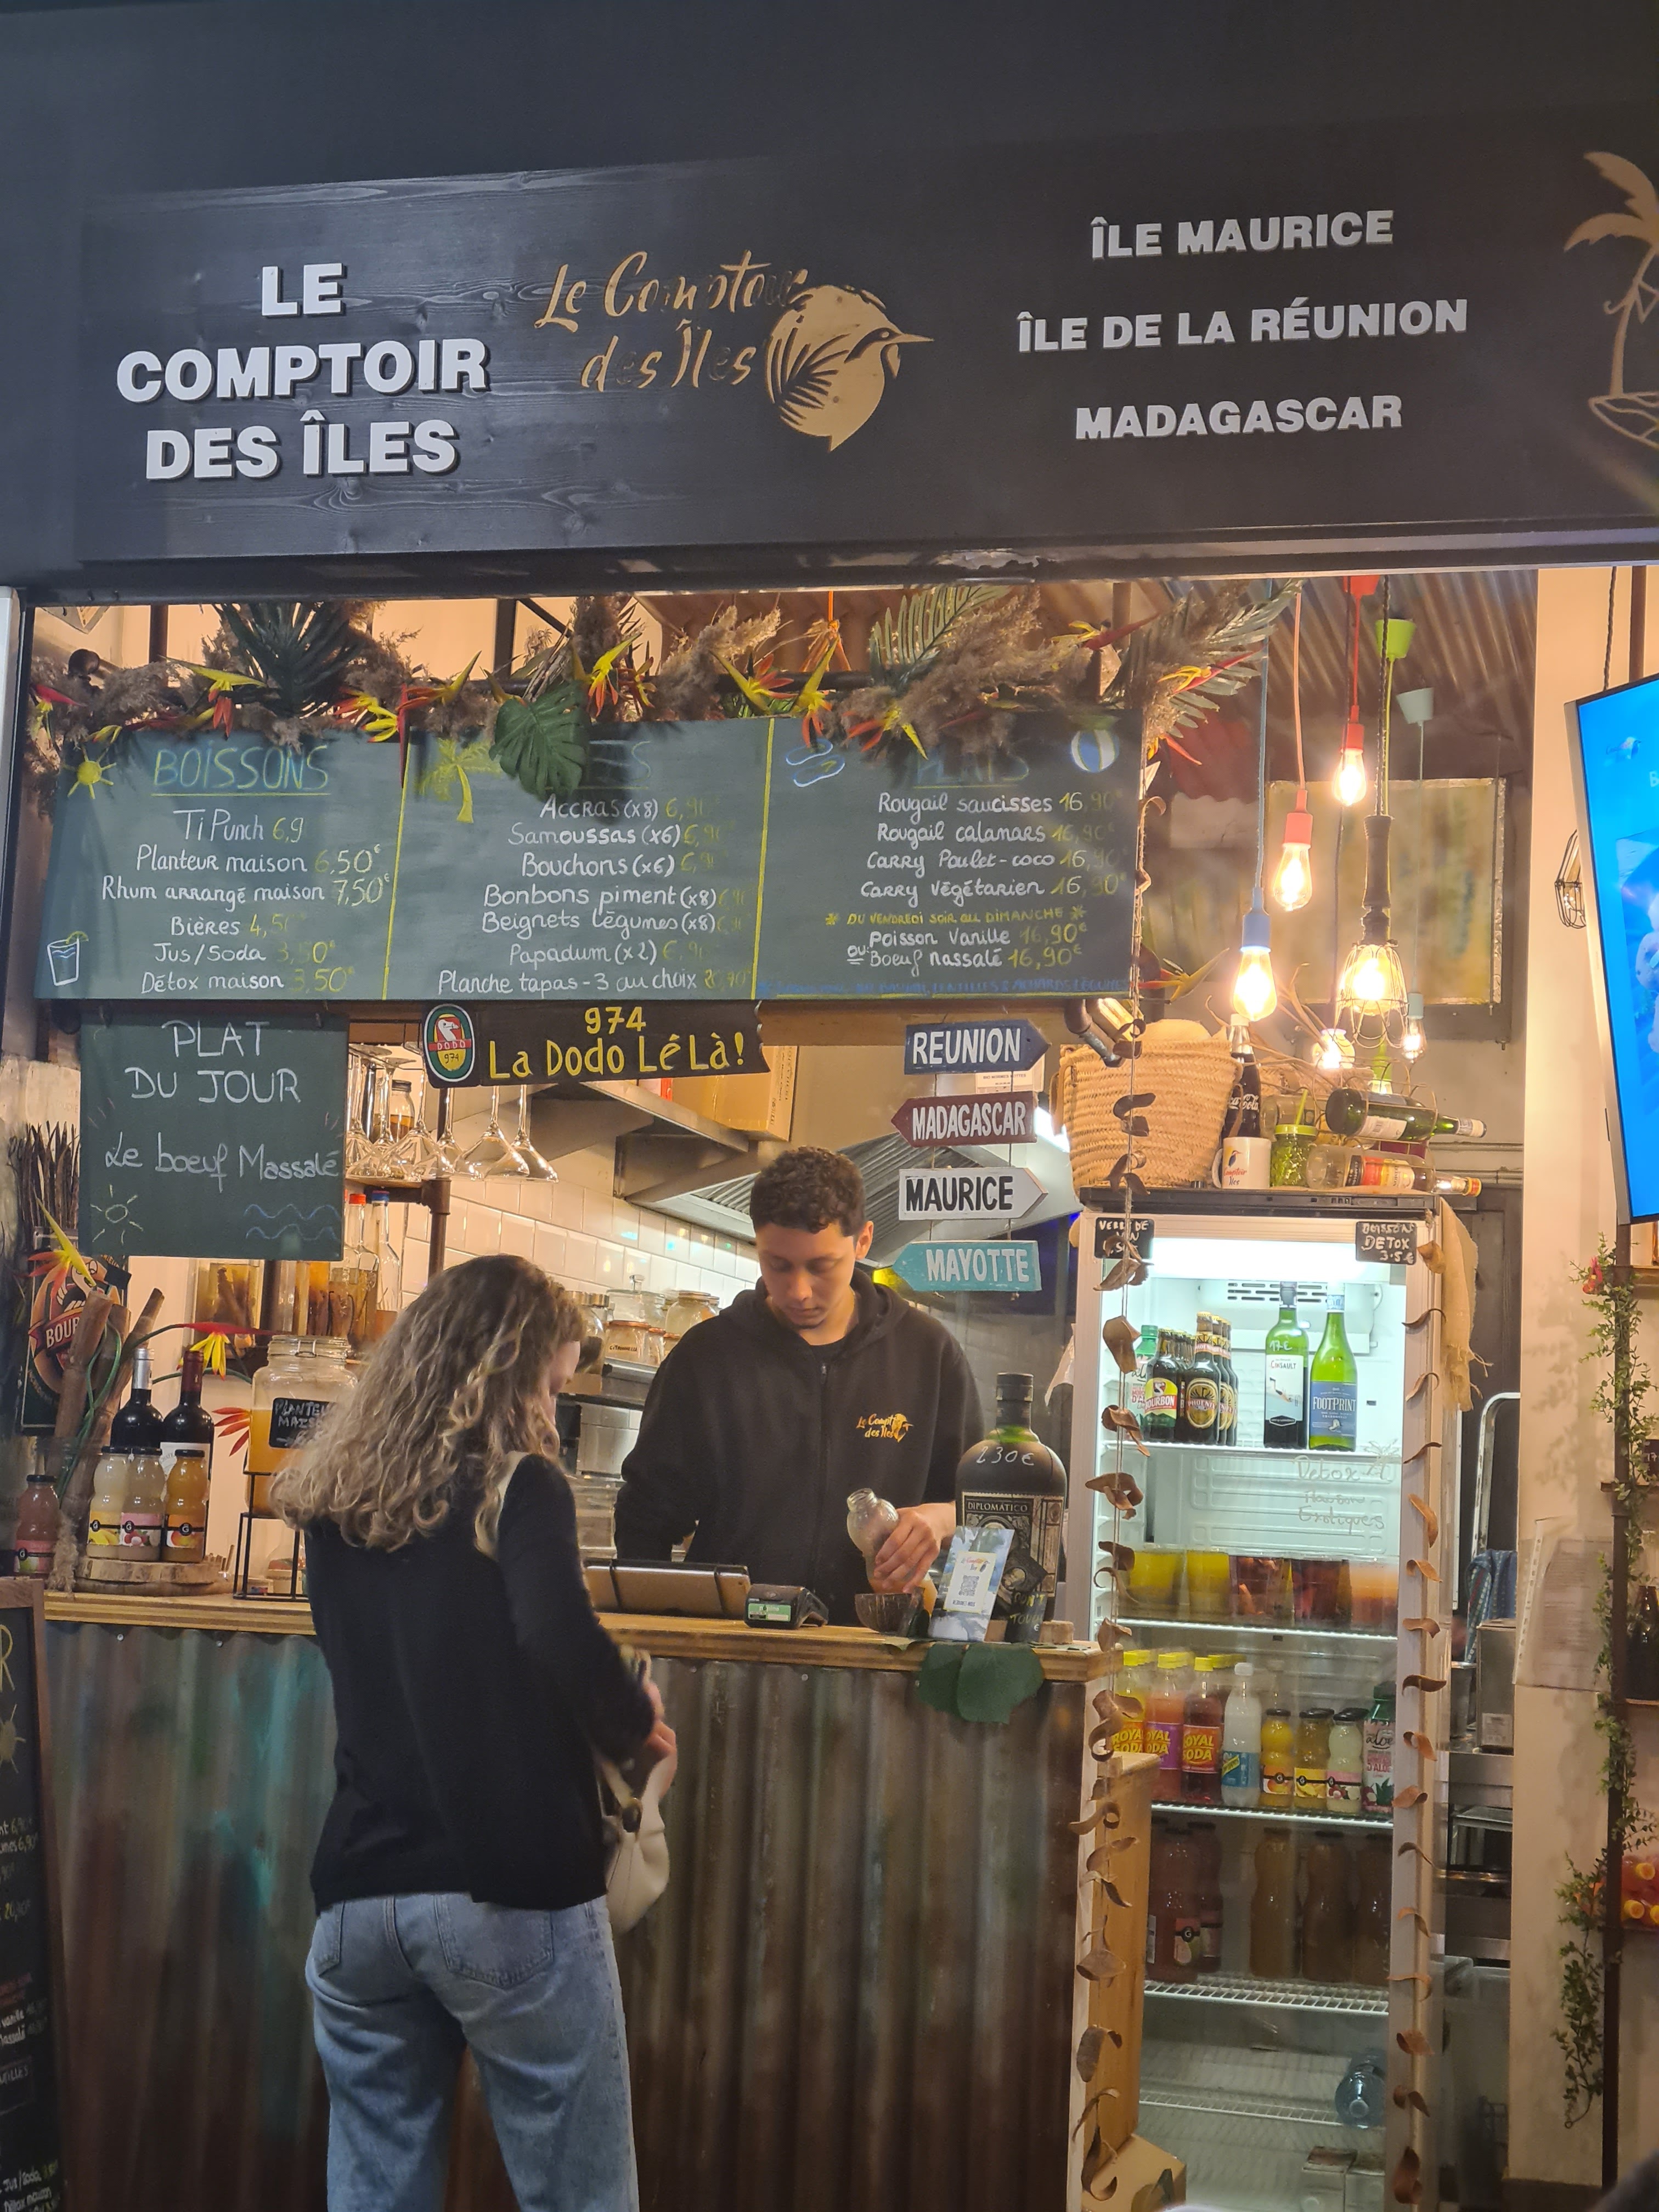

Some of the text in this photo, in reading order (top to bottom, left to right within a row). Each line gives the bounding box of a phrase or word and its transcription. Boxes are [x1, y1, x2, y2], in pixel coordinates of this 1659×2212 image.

[1091, 210, 1393, 260] ÎLE MAURICE
[262, 263, 345, 317] LE
[534, 263, 586, 333] Le
[1017, 296, 1468, 352] ÎLE DE LA RÉUNION
[117, 338, 489, 403] COMPTOIR
[580, 335, 663, 392] des
[1076, 395, 1402, 441] MADAGASCAR
[146, 409, 459, 479] DES ÎLES
[154, 744, 329, 789] BOISSONS
[878, 791, 948, 822] Rougail
[956, 795, 1053, 813] saucisses
[508, 822, 636, 845] Samoussas
[878, 822, 944, 850] Rougail
[227, 856, 307, 873] maison
[522, 852, 628, 877] Bouchons
[102, 876, 157, 900] Rhum
[253, 884, 325, 901] maison
[483, 884, 589, 907] Bonbons
[600, 885, 676, 917] piment
[482, 910, 580, 940] Beignets
[592, 908, 678, 940] légumes
[510, 945, 611, 970] Papadum
[870, 950, 923, 978] Boeuf
[141, 972, 284, 994] Détox maison
[439, 969, 513, 995] Planche
[519, 974, 578, 998] tapas
[596, 973, 609, 990] 3
[617, 974, 649, 989] au
[652, 968, 696, 989] choix
[584, 1006, 646, 1035] 974
[161, 1019, 269, 1058] PLAT
[437, 1040, 466, 1050] DODO
[913, 1028, 1020, 1065] REUNION
[444, 1053, 459, 1064] 974
[489, 1040, 534, 1079] La
[546, 1037, 625, 1076] Dodo
[639, 1034, 681, 1073] Lé
[125, 1067, 301, 1103] DU JOUR
[912, 1101, 1026, 1141] MADAGASCAR
[105, 1131, 339, 1193] Le boeuf Massalé
[905, 1176, 1013, 1212] MAURICE
[1136, 1220, 1149, 1231] DE
[1361, 1235, 1409, 1251] DETOX
[926, 1248, 1030, 1283] MAYOTTE
[275, 1400, 329, 1416] PLANTEU
[1145, 1396, 1175, 1409] BOURBON
[1188, 1400, 1215, 1409] PHOENIX
[1313, 1396, 1356, 1412] FOOTPRINT
[865, 1427, 880, 1438] des
[1293, 1455, 1360, 1481] Detox
[1111, 1728, 1142, 1743] ROYA
